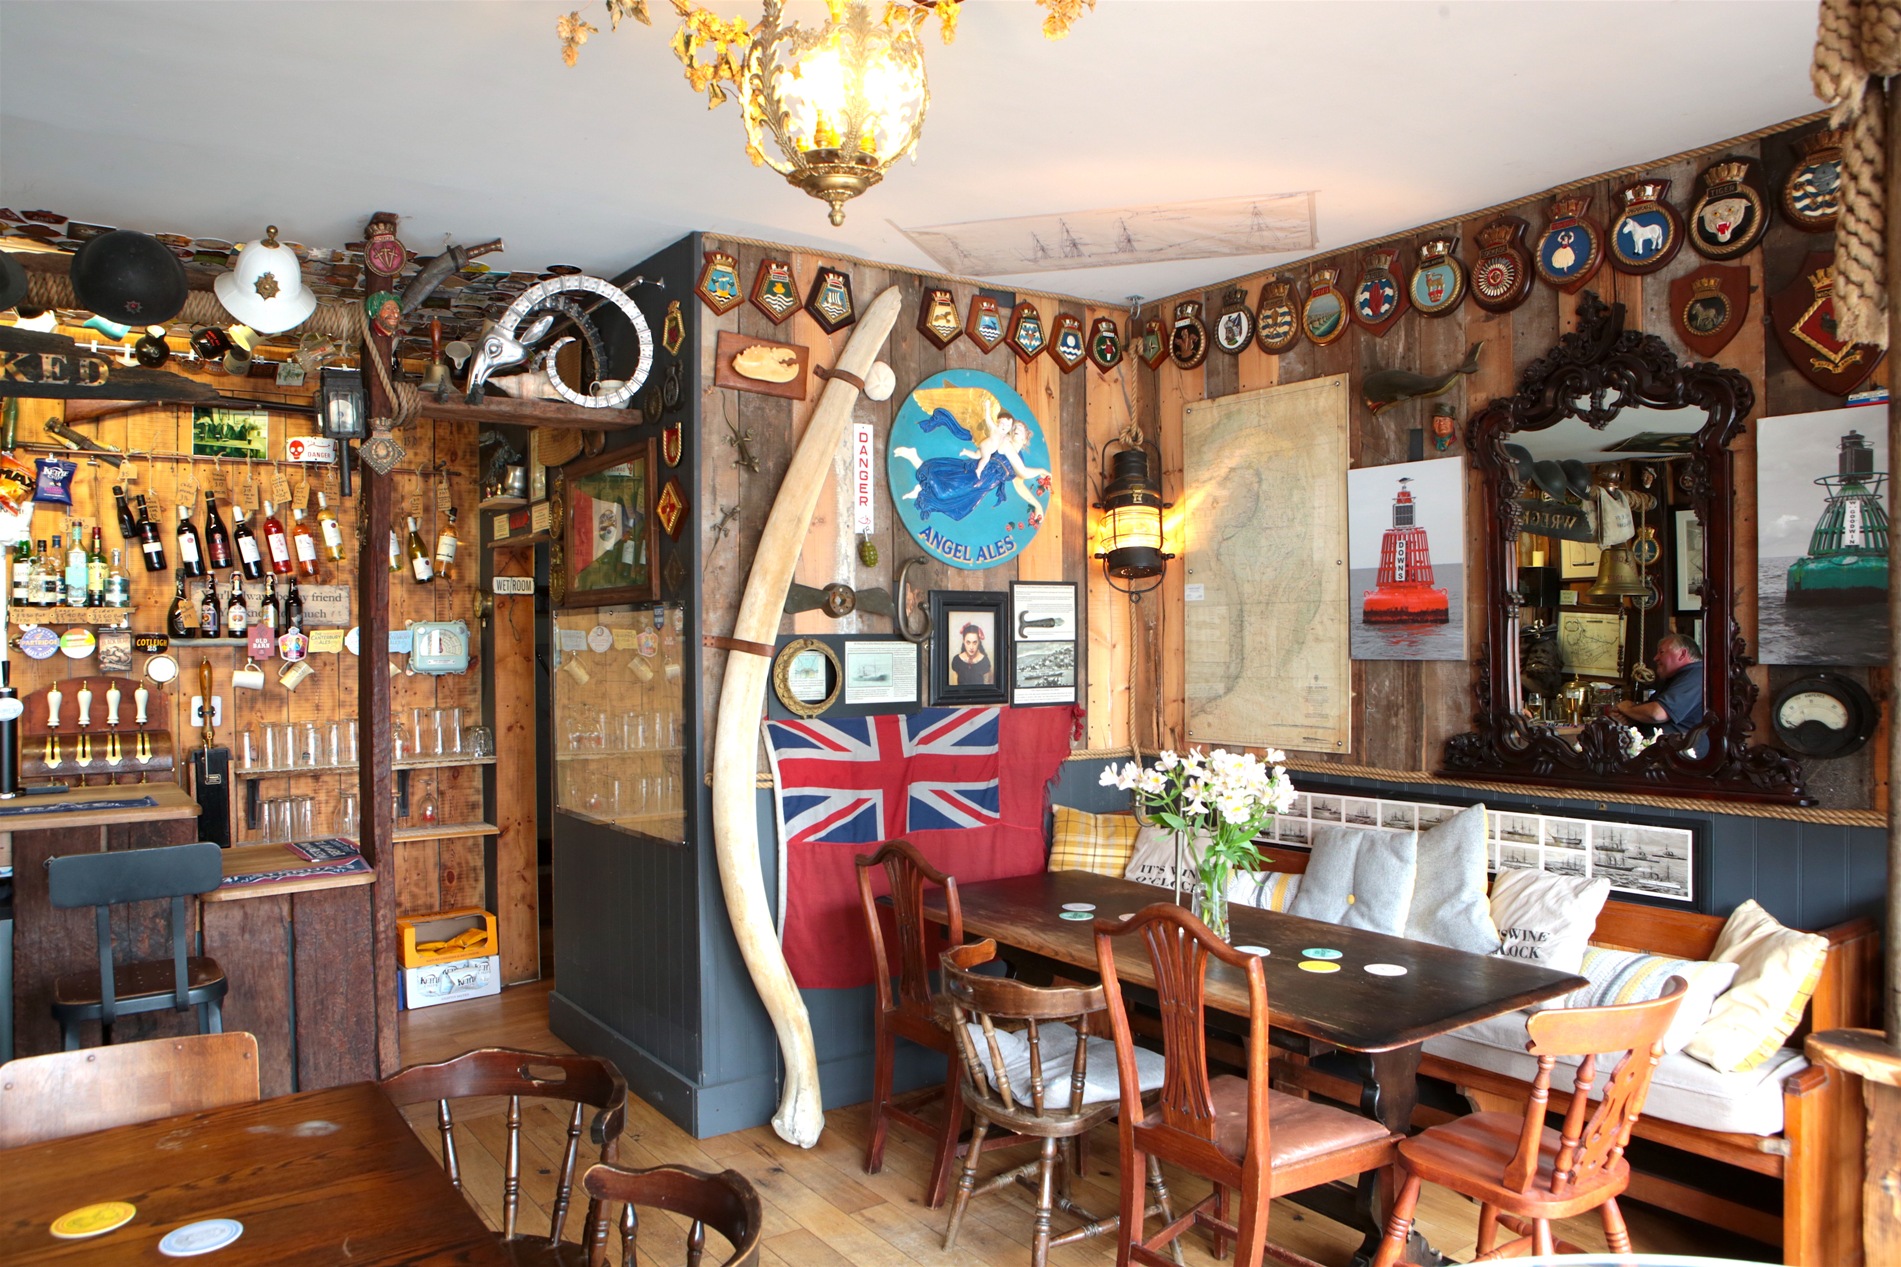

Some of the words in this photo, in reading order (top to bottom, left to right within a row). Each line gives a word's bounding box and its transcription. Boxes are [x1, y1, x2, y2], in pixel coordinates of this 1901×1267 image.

[1709, 184, 1736, 197] TIGER
[0, 351, 109, 387] KED
[307, 451, 331, 459] DANGER
[859, 432, 869, 506] DANGER
[918, 525, 973, 565] ANGEL
[976, 535, 1018, 564] ALES
[1397, 541, 1405, 580] DOWNS
[496, 579, 510, 592] WET
[512, 579, 532, 592] ROOM
[311, 589, 342, 602] friend
[136, 638, 168, 647] COTLEIGH
[1140, 864, 1165, 875] IT'S
[1508, 927, 1550, 943] WINE
